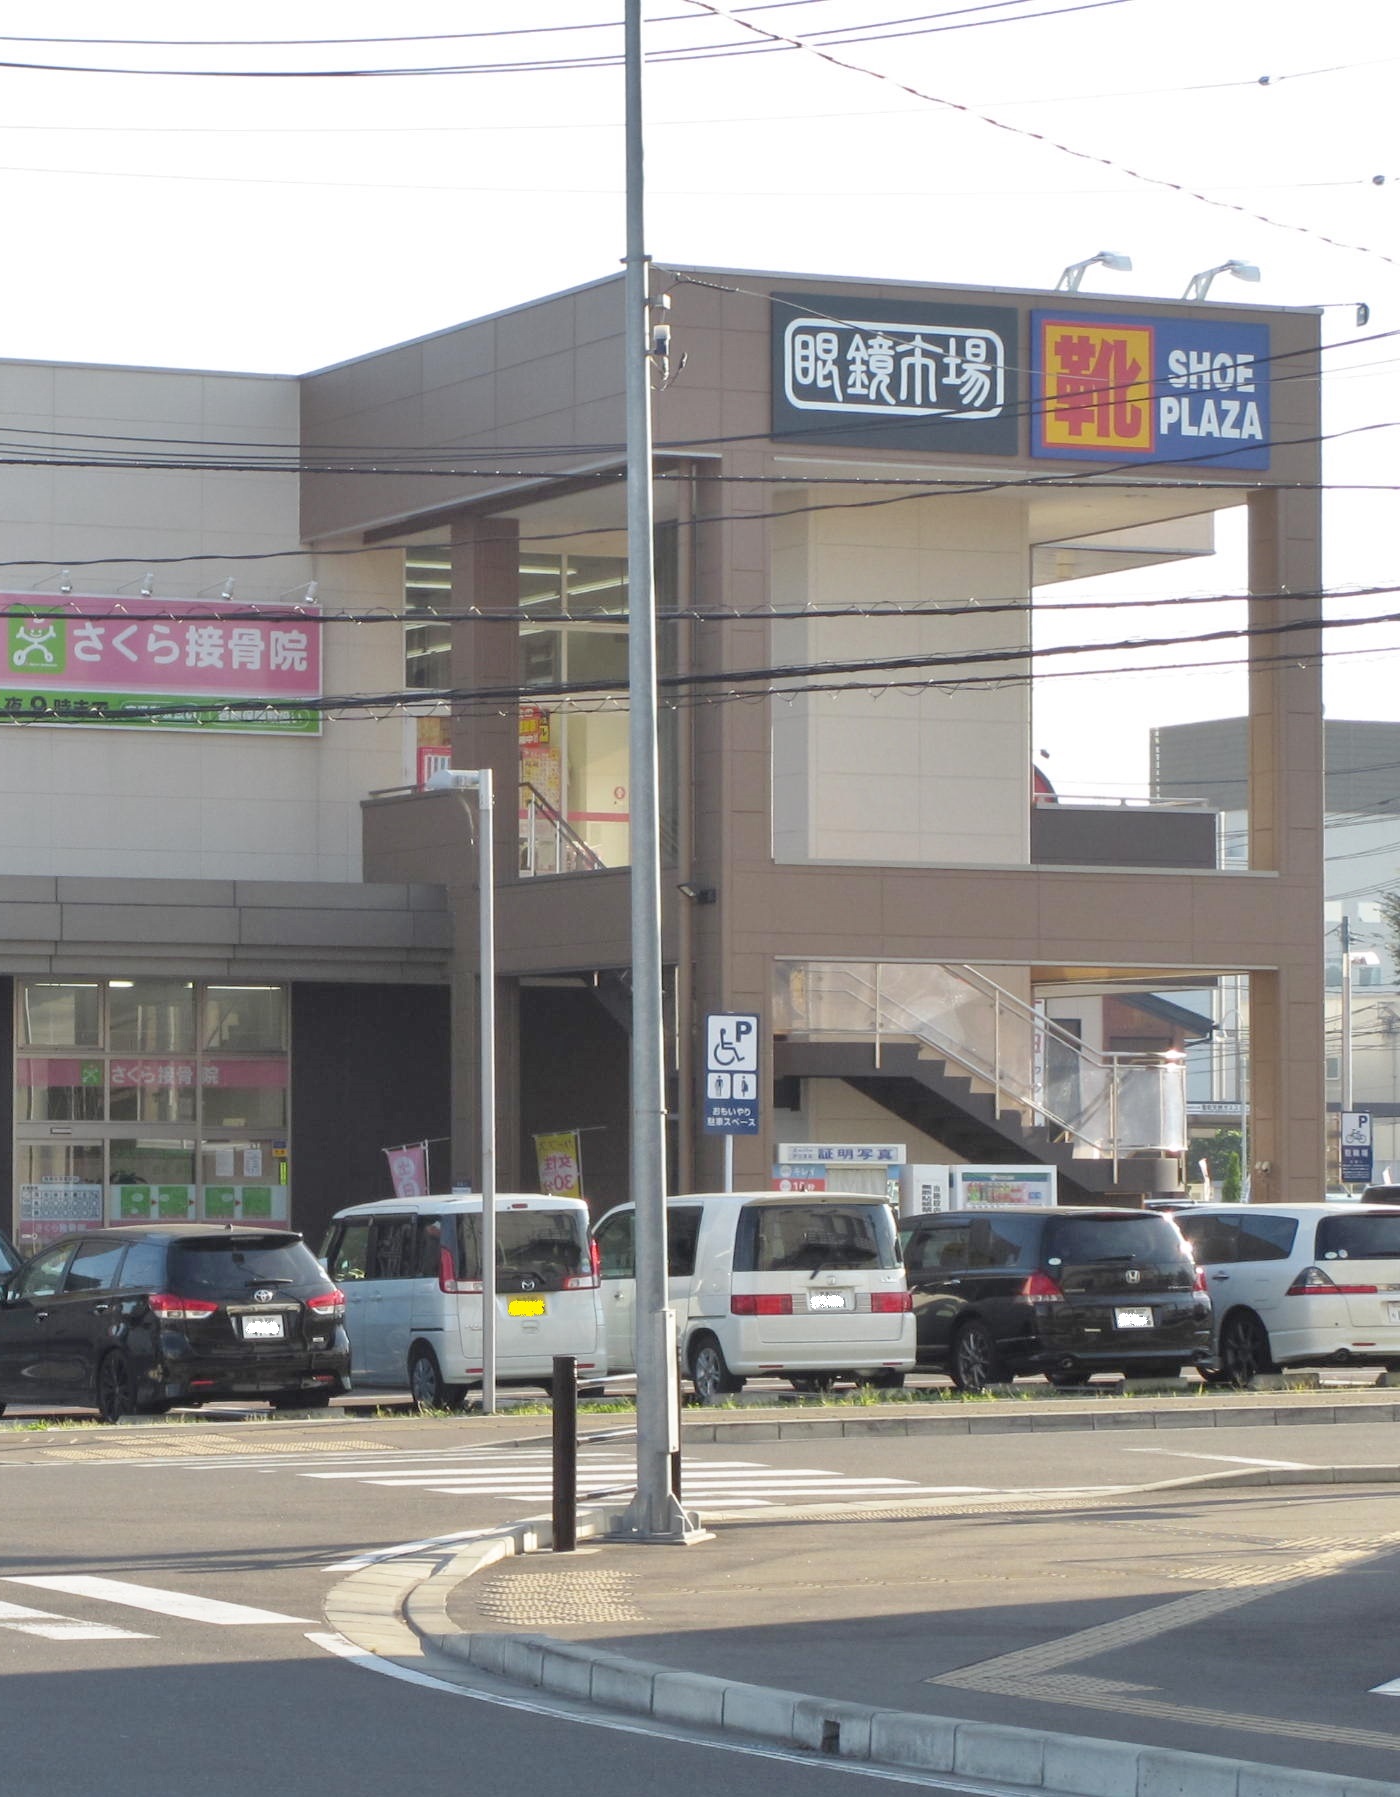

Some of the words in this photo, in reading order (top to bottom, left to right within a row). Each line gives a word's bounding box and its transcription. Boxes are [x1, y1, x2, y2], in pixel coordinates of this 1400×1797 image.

[794, 332, 993, 407] 眼鏡市場
[1167, 350, 1256, 393] SHOE
[1054, 334, 1142, 439] 靴
[1160, 397, 1264, 440] PLAZA
[73, 621, 308, 672] さくら接骨院
[736, 1021, 752, 1042] P
[707, 1117, 756, 1127] 駐車スペース
[712, 1107, 751, 1117] おもいやり
[1358, 1115, 1368, 1128] P
[818, 1148, 893, 1160] 証明写真
